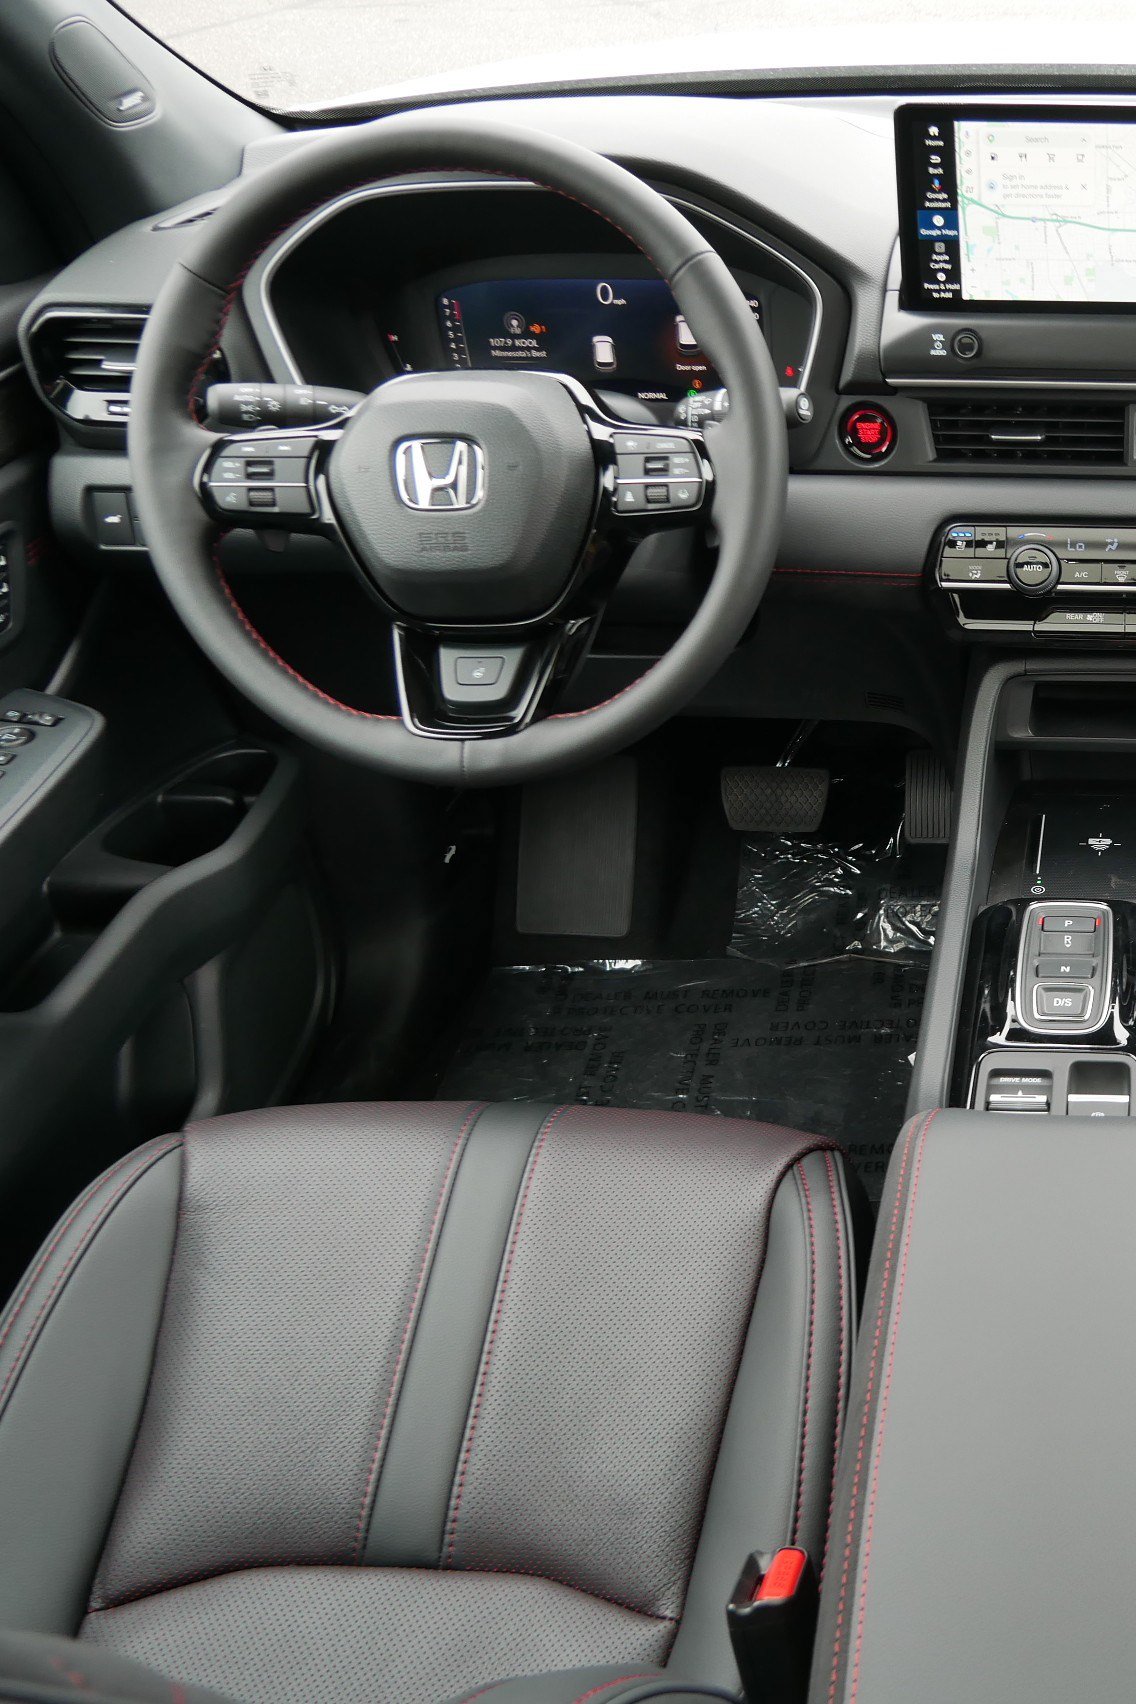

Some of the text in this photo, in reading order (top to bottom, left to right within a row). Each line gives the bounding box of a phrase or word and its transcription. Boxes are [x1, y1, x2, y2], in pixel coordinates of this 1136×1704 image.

[925, 139, 944, 147] Home
[1025, 135, 1049, 144] Search
[1002, 173, 1017, 182] Sign
[926, 192, 948, 200] Google
[920, 228, 942, 237] Google
[595, 282, 613, 305] 0
[489, 338, 539, 347] 107.9 KOOL
[490, 349, 548, 358] Minnesota's Best
[638, 392, 669, 400] NORMAL
[1023, 564, 1043, 572] AUTO
[1064, 935, 1072, 943] R
[644, 989, 689, 1000] MUST
[701, 987, 771, 999] REMOVE
[1053, 998, 1072, 1007] D/S
[674, 1003, 734, 1014] COVER
[769, 1020, 829, 1031] COVER
[728, 1036, 804, 1048] REMOVE
[812, 1035, 862, 1046] MUST
[694, 1074, 715, 1110] MUST
